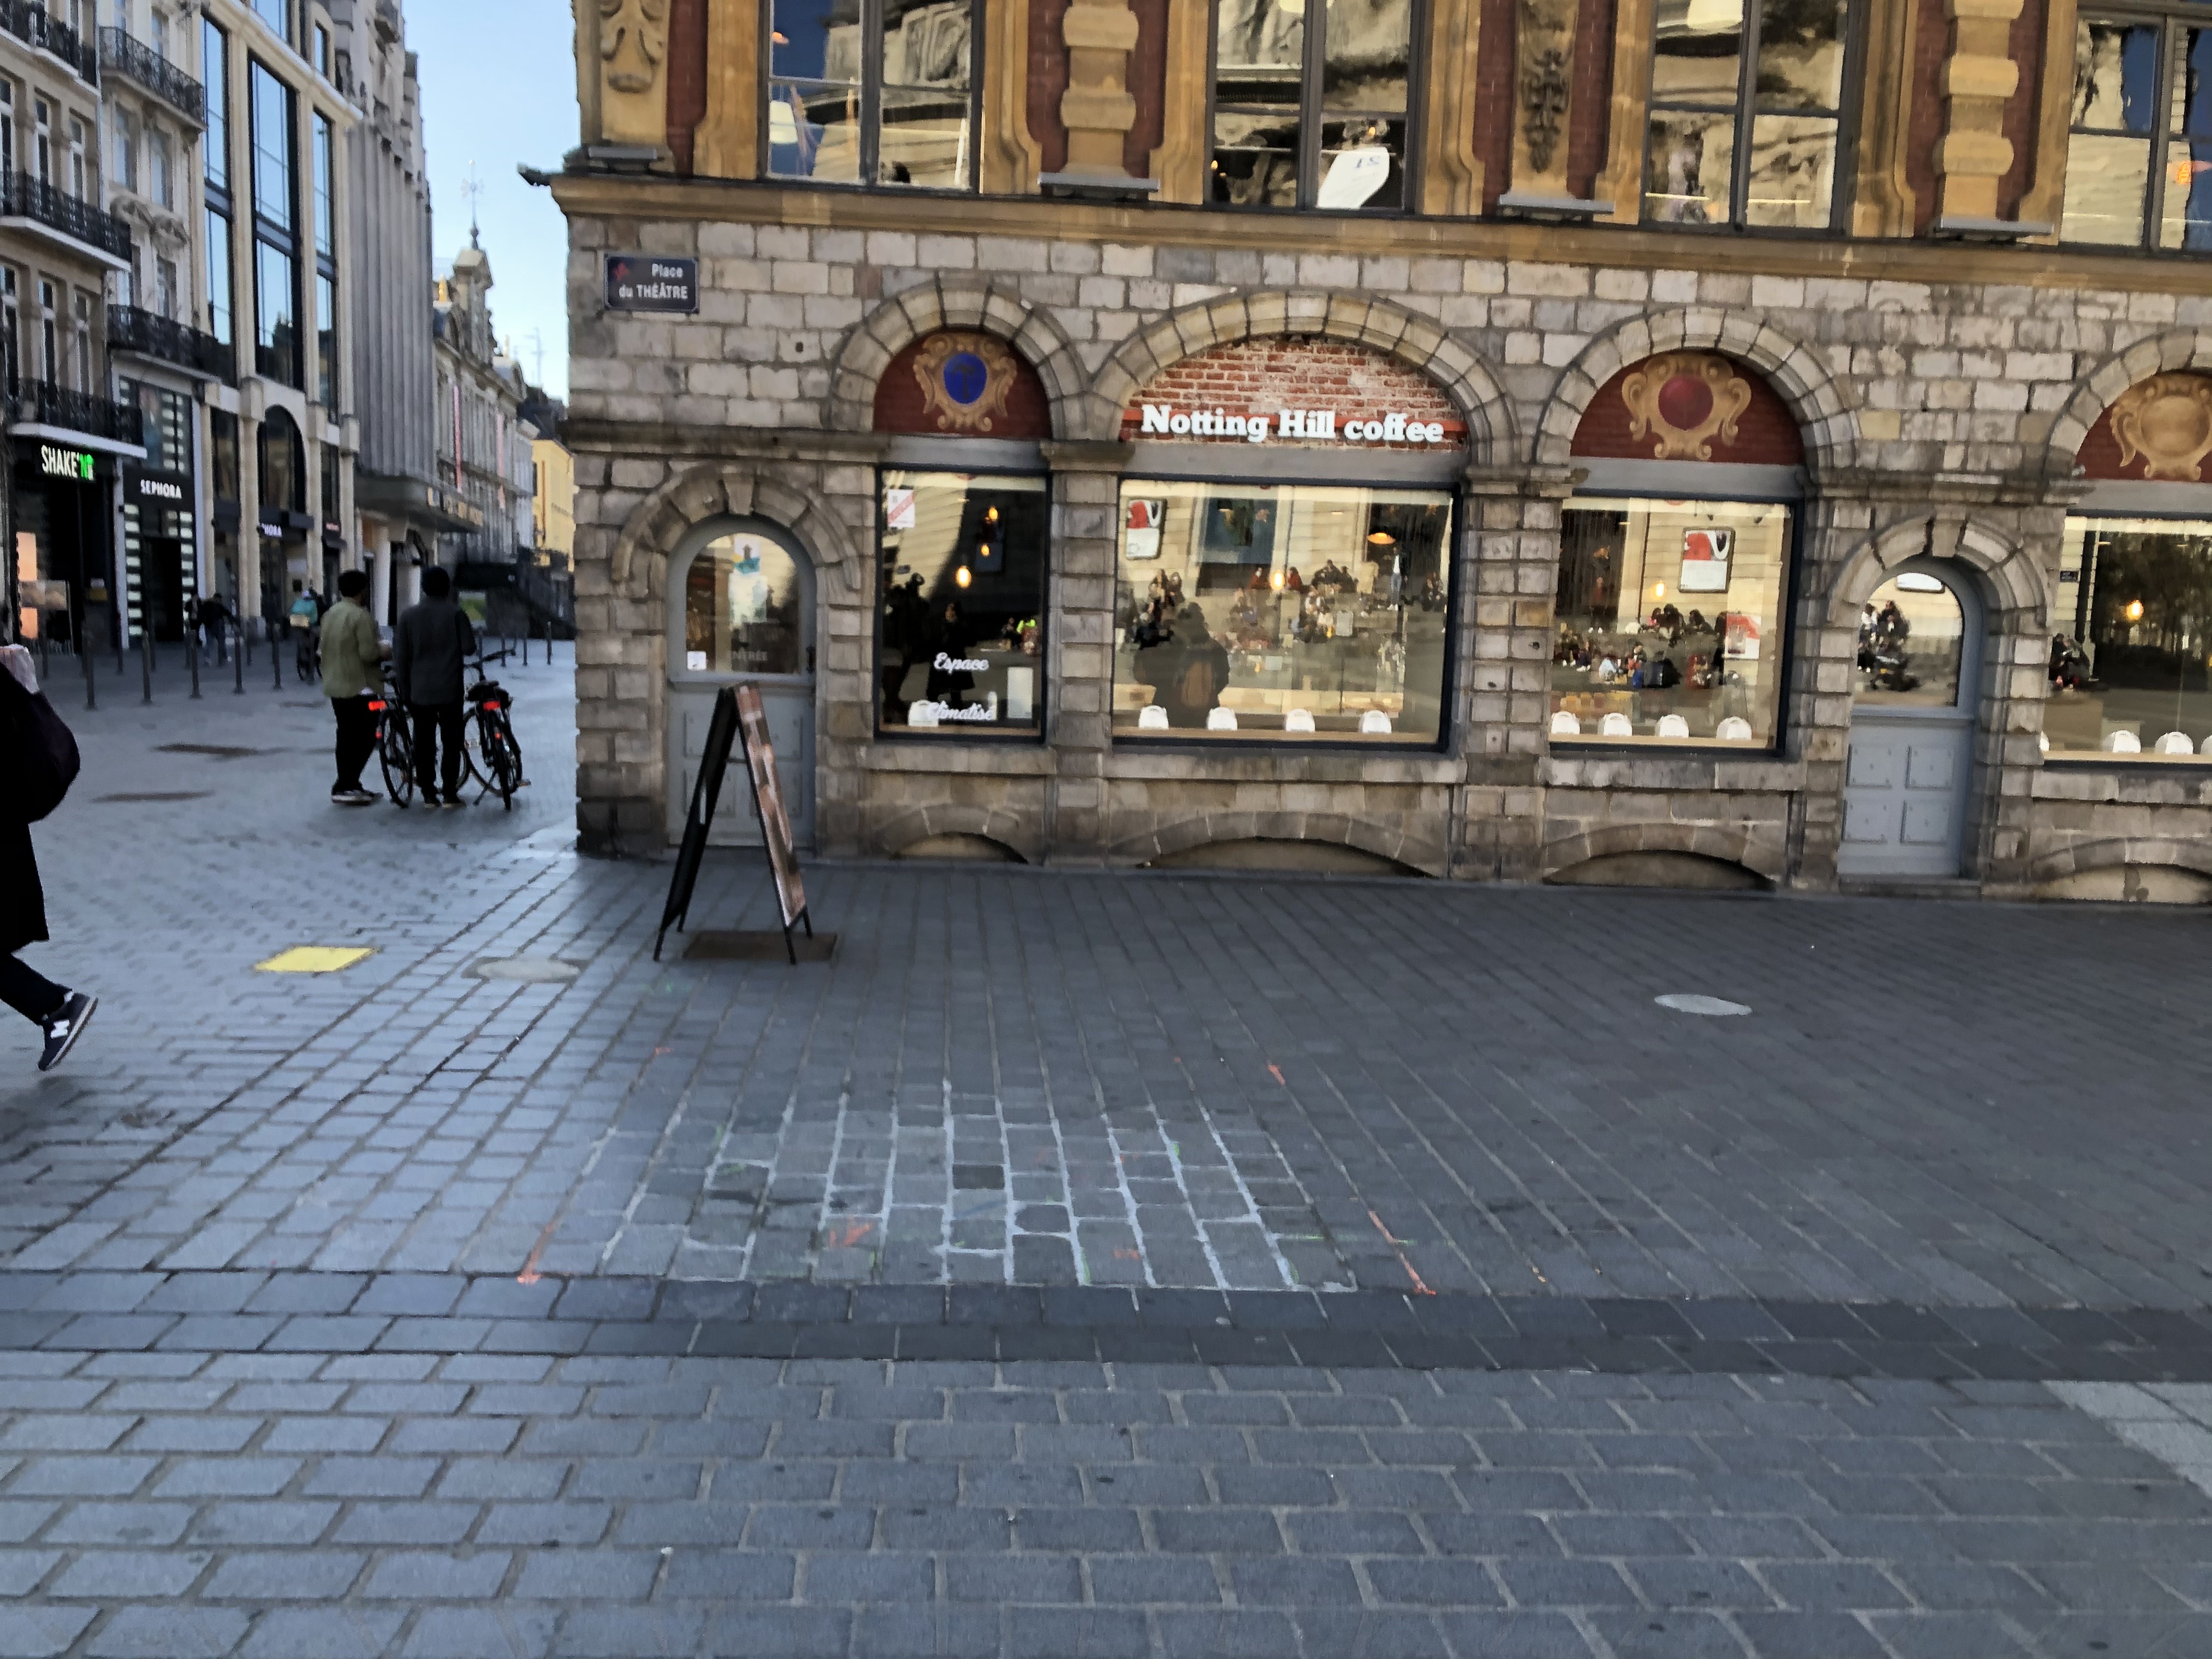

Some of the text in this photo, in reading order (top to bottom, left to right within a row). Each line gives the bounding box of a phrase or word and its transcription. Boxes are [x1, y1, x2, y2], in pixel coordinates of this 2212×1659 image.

[651, 263, 684, 278] Place
[619, 282, 689, 300] du THÉÂTRE
[1141, 404, 1444, 442] Notting Hill coffee
[140, 479, 182, 499] SEPHORA
[934, 652, 989, 675] Espace
